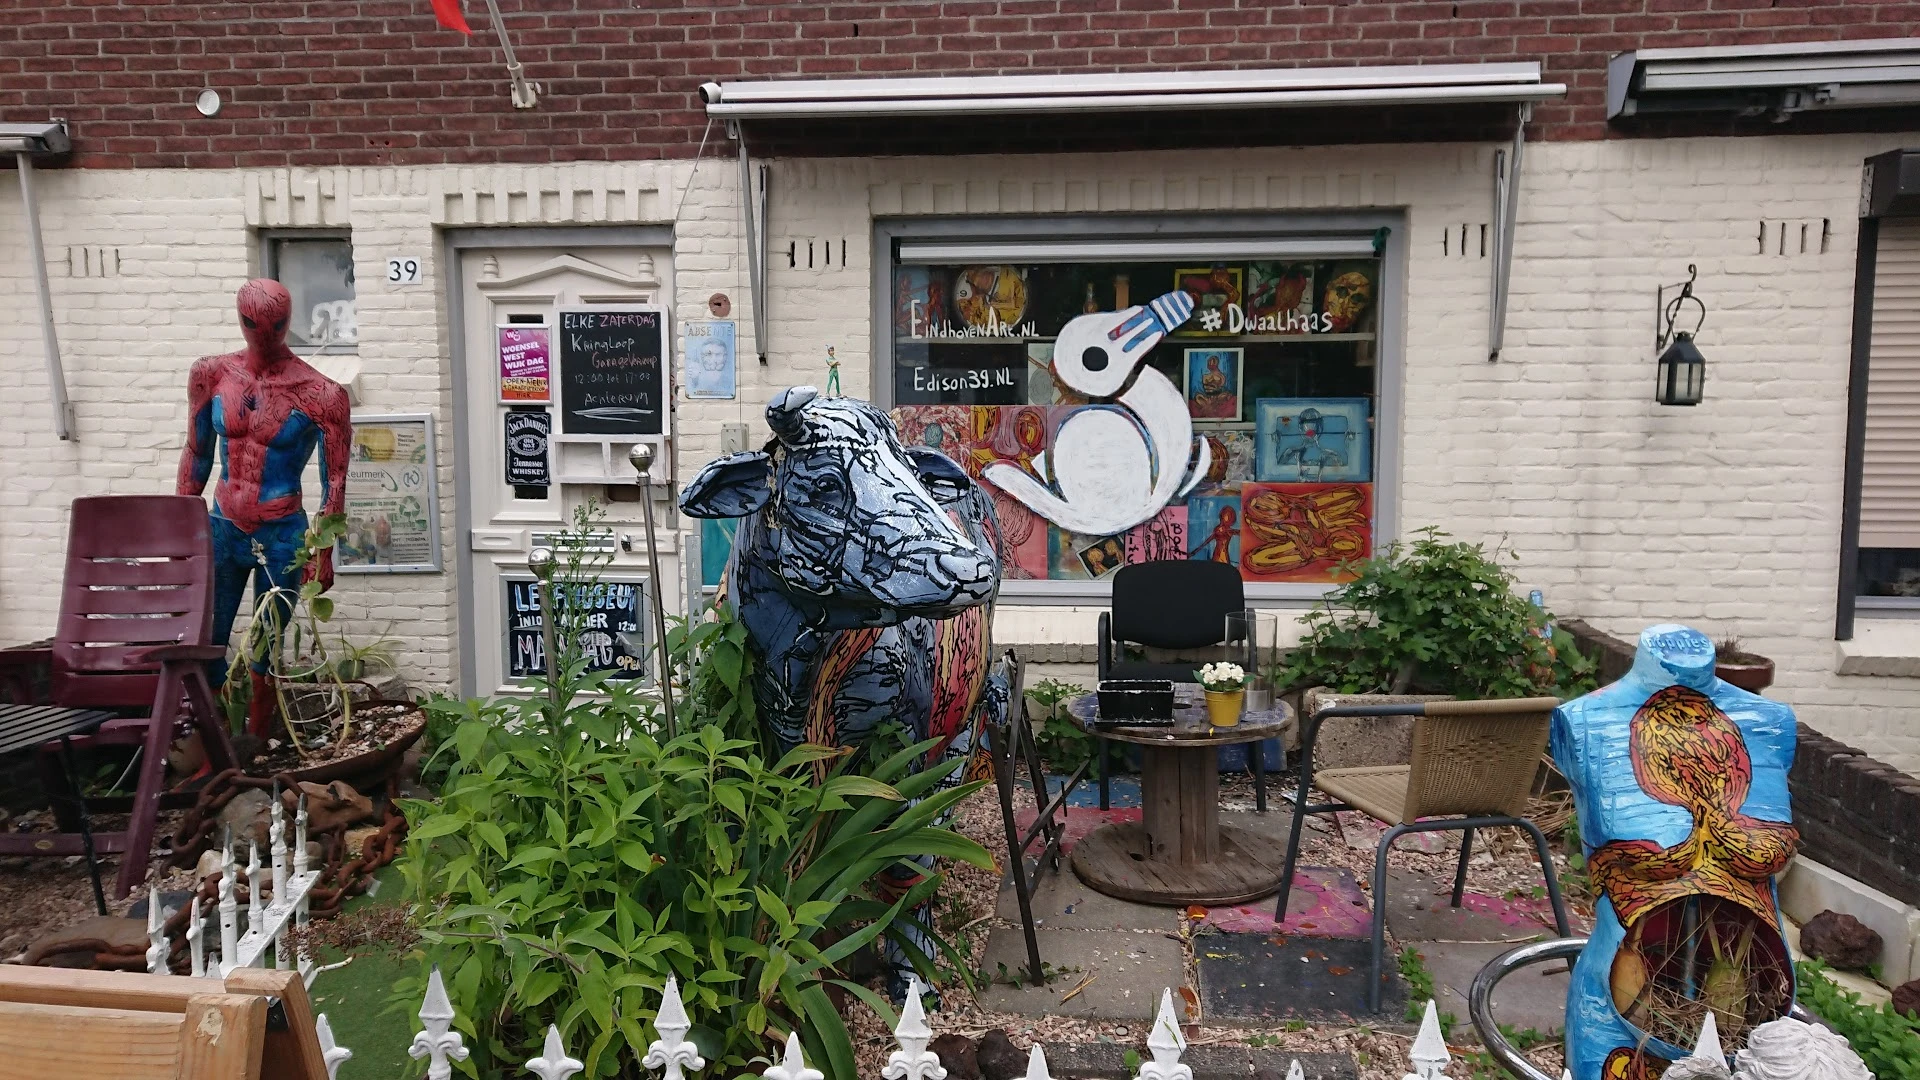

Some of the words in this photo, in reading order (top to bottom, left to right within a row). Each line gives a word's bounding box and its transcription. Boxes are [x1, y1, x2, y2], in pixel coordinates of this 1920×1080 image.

[388, 260, 418, 283] 39
[564, 313, 595, 329] ELKE
[599, 313, 655, 328] ZATERDAG
[1200, 303, 1333, 334] #Dwaalhaas
[501, 341, 540, 354] WOENSEL
[503, 351, 526, 362] WEST
[504, 360, 525, 370] WIJK
[526, 356, 544, 366] DAG
[914, 366, 1015, 392] Edison39.NL
[509, 420, 525, 435] JACK
[524, 417, 547, 435] DANIEL'S
[513, 457, 544, 468] Tennessee
[512, 468, 545, 476] WHISKEY
[1645, 637, 1710, 652] noppies
